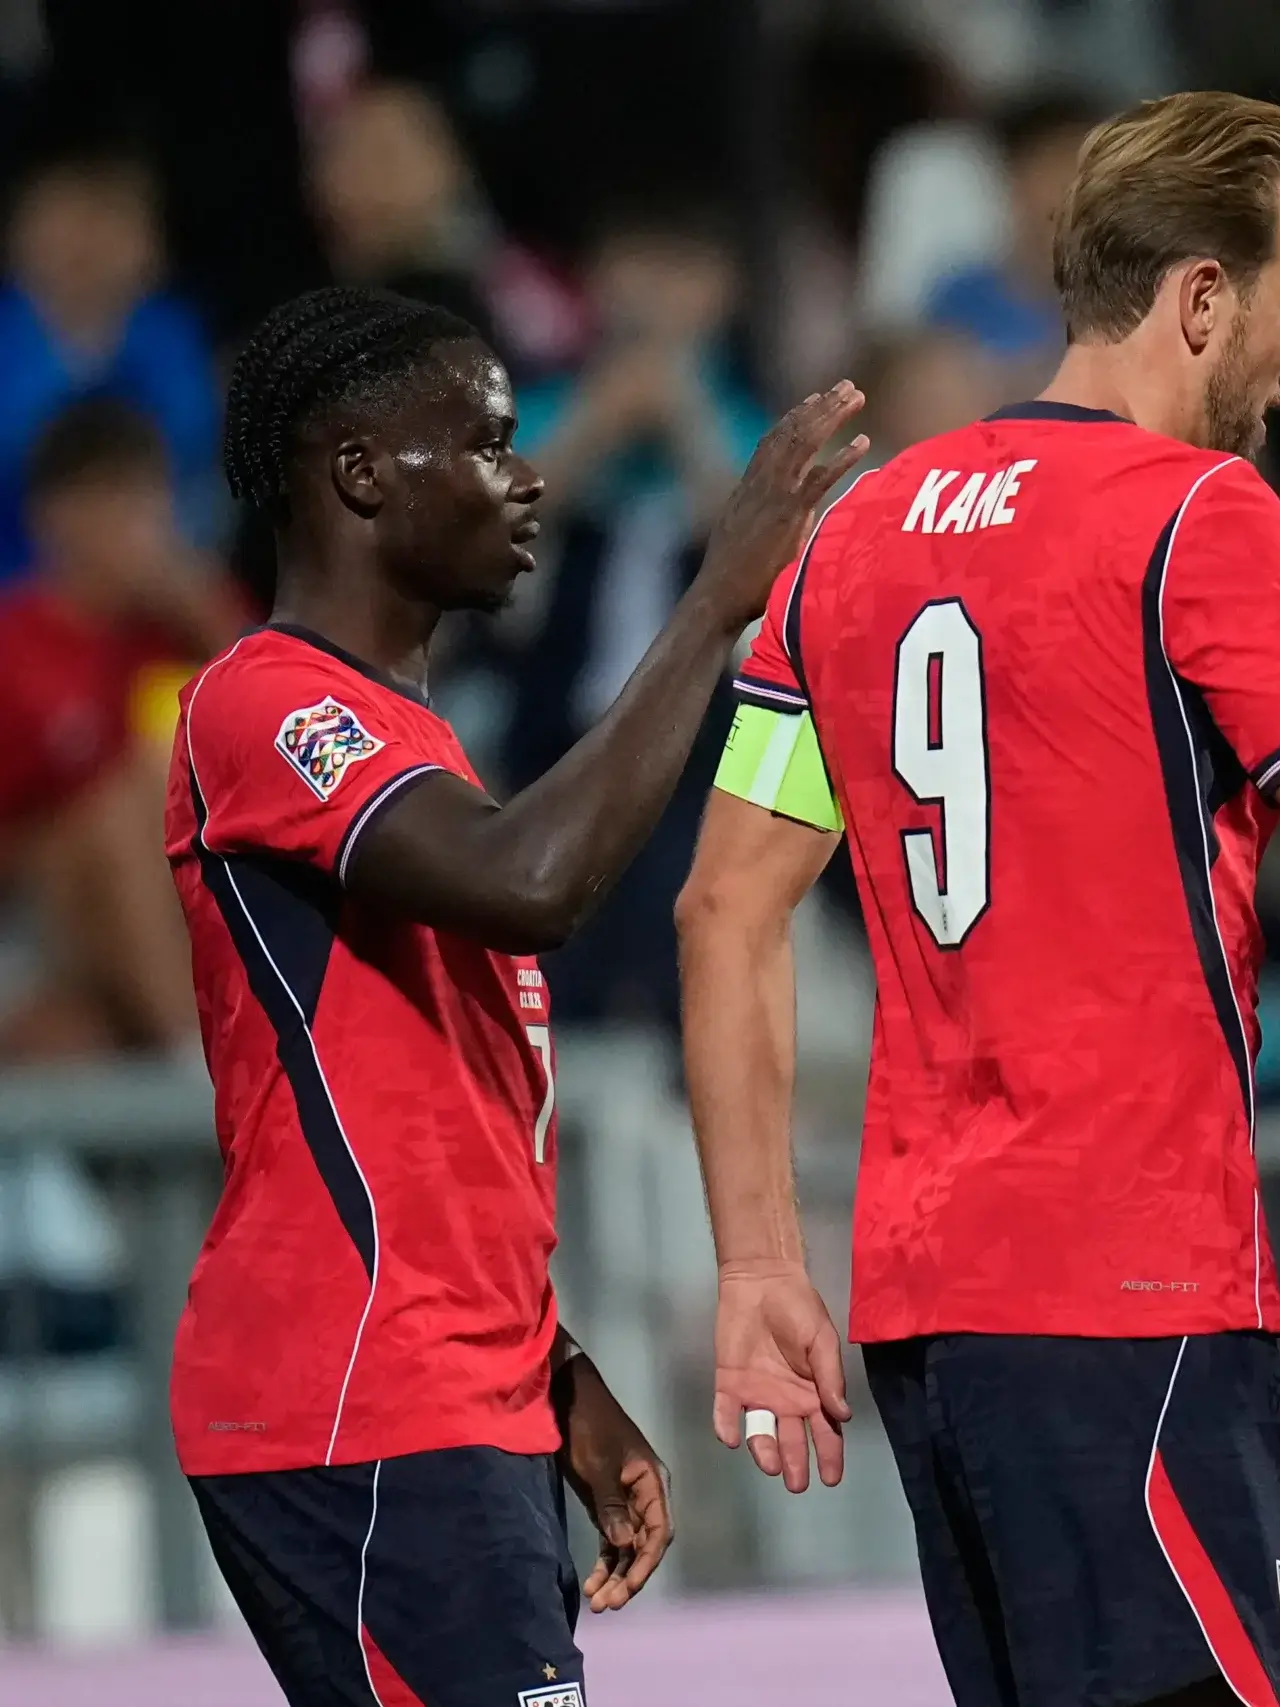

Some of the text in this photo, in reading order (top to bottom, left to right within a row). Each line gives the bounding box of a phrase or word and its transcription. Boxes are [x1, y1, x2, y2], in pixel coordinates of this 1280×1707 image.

[901, 459, 1038, 534] KANE
[892, 597, 991, 950] 9
[525, 1023, 555, 1164] 7
[1120, 1280, 1199, 1292] AERO-FIT
